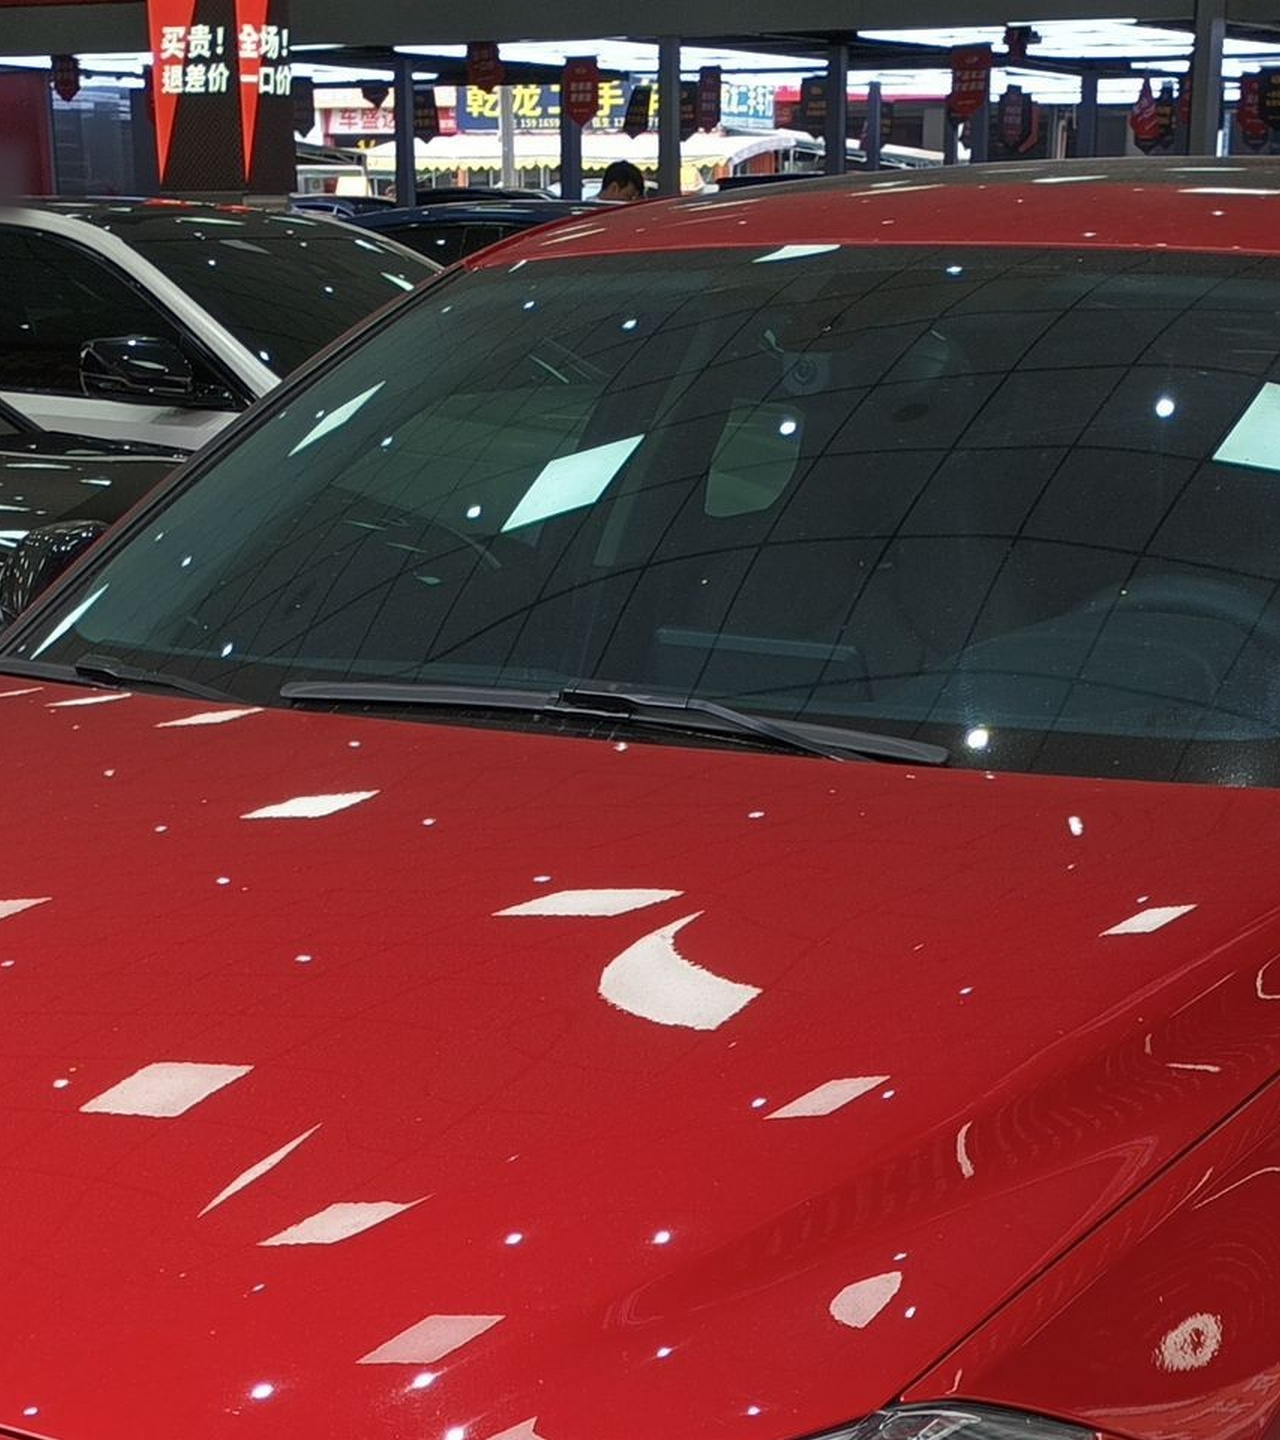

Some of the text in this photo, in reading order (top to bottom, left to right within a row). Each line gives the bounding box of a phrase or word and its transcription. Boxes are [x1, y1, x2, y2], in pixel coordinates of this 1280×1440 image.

[160, 23, 225, 59] 买贵!
[237, 23, 289, 59] 全场!
[161, 63, 230, 95] 退差价
[239, 65, 292, 97] 一口价
